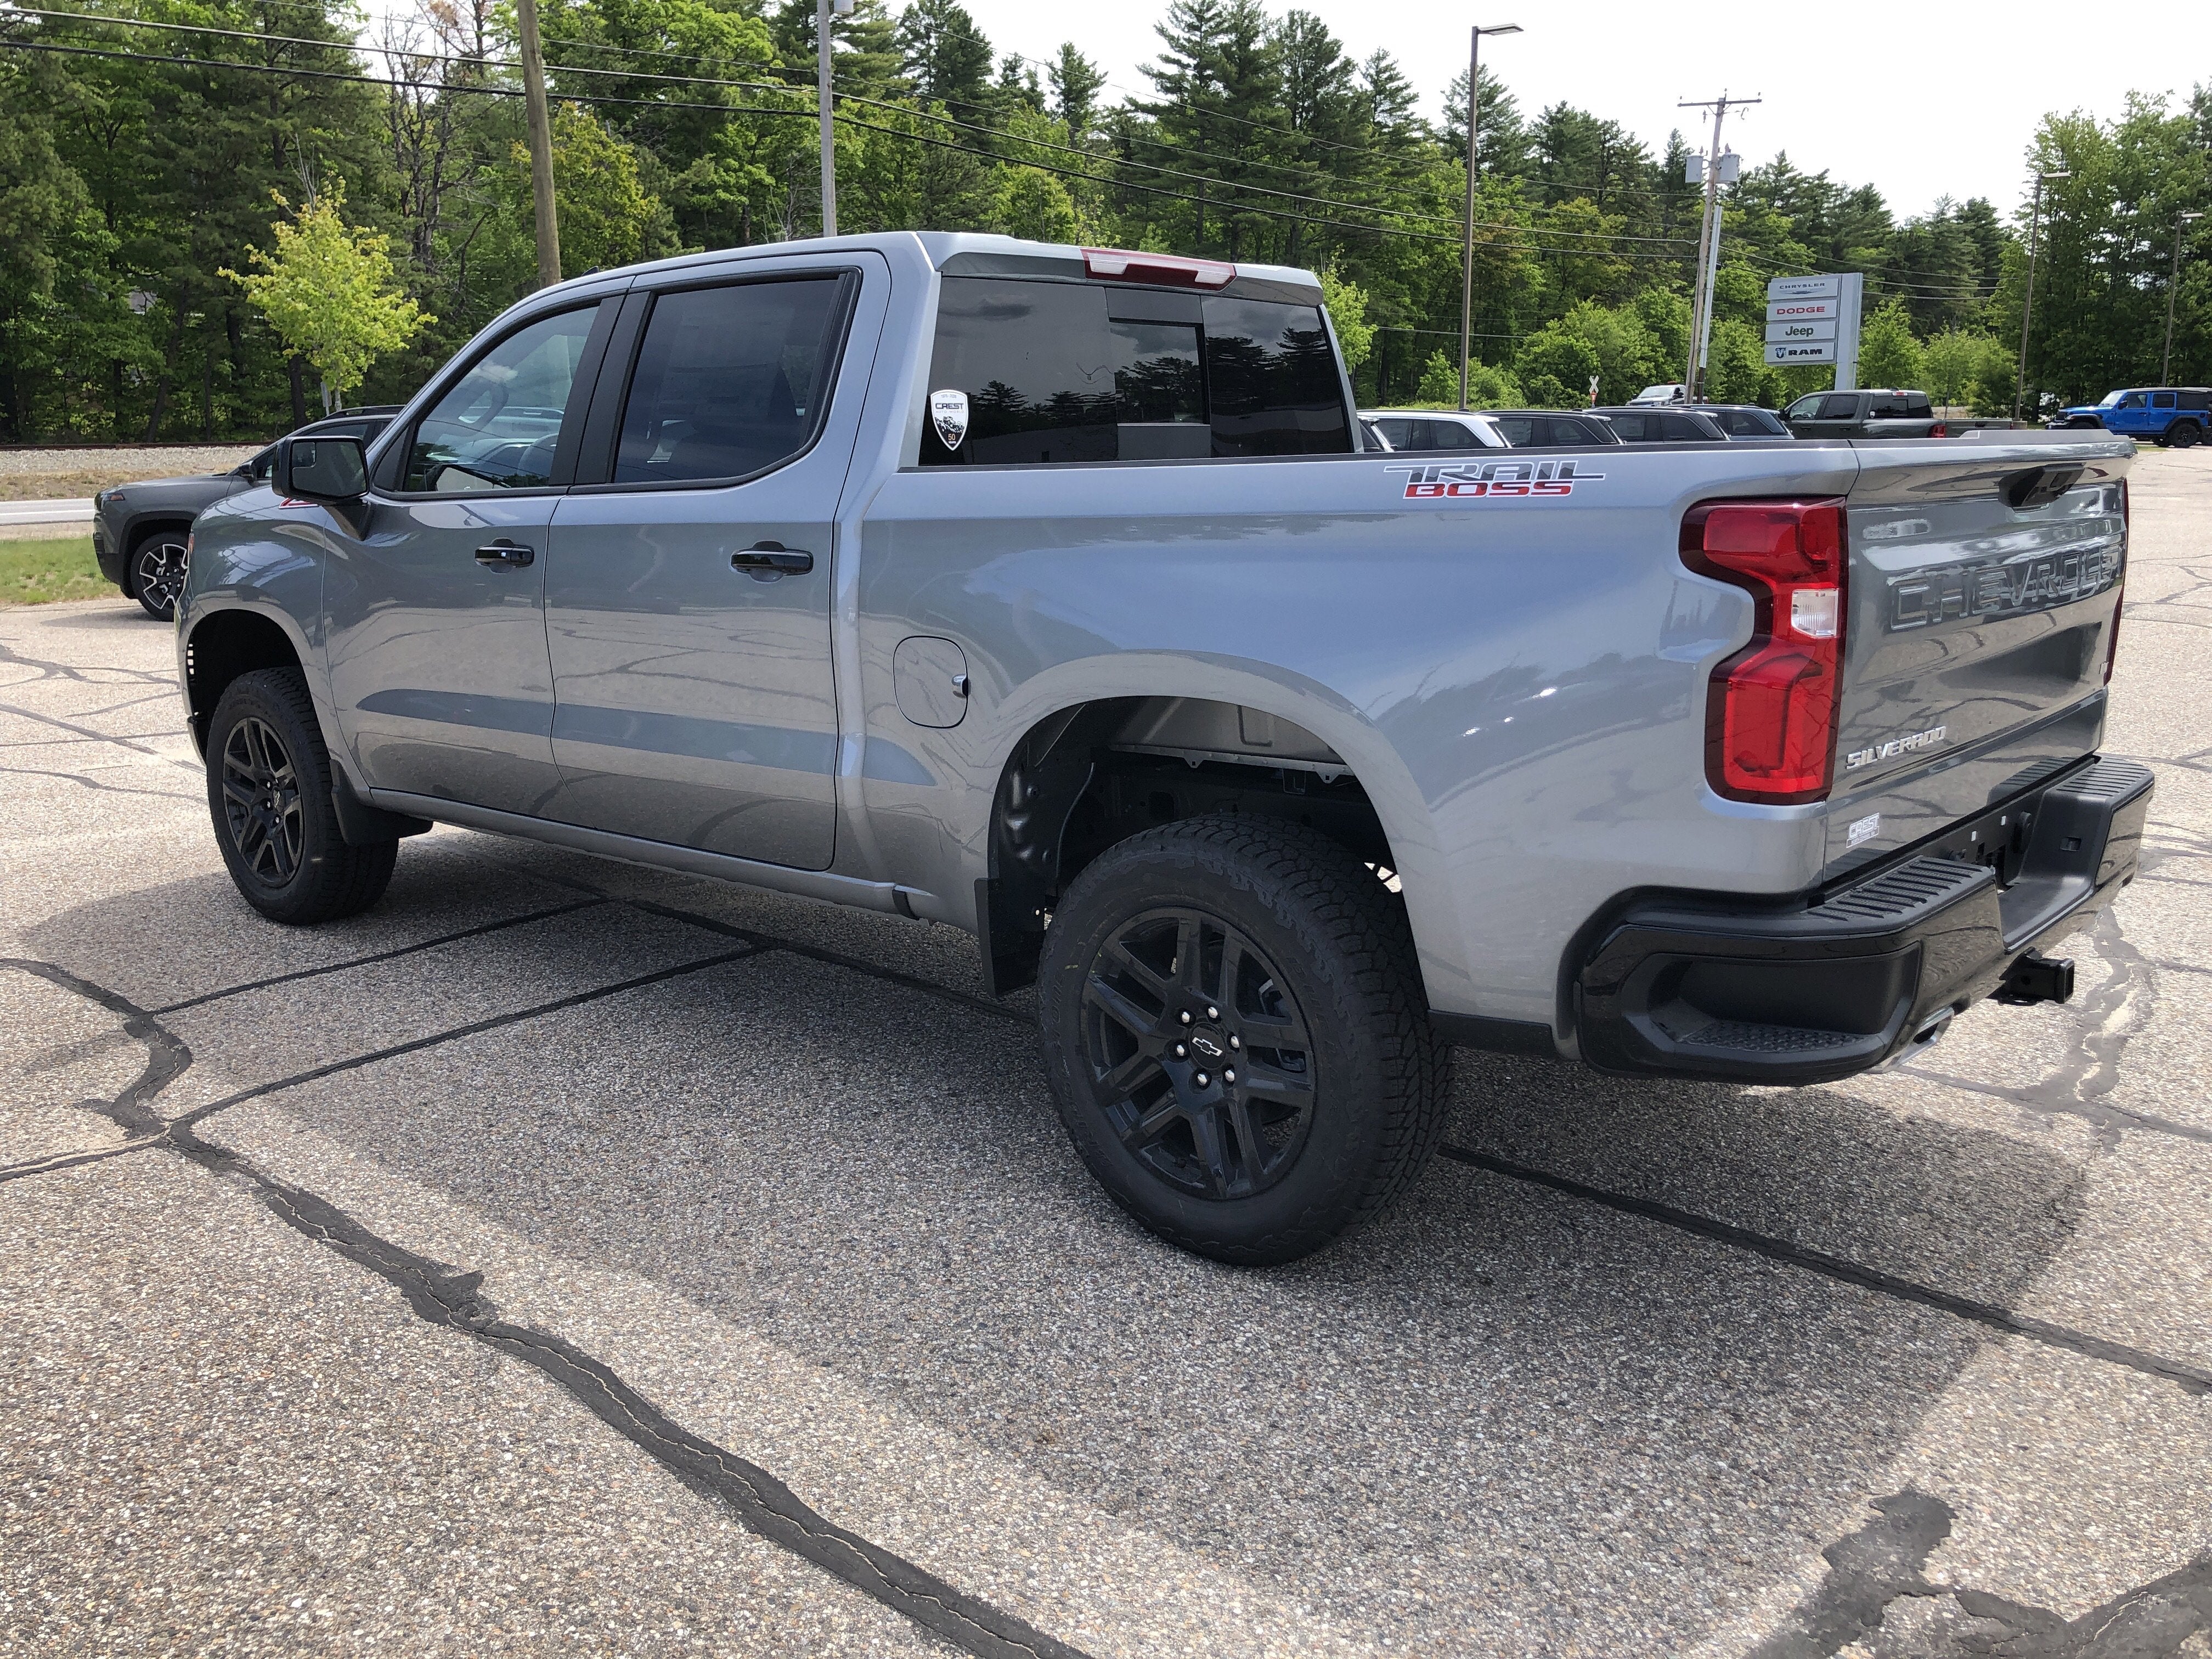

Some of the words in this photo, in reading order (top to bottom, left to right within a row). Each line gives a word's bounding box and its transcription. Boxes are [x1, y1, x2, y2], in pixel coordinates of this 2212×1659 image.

[1776, 306, 1825, 315] DODGE
[1785, 326, 1814, 337] Jeep
[1383, 460, 1606, 483] TRAIL
[1403, 480, 1575, 499] BOSS
[1891, 544, 2123, 631] CHEVROLET
[1846, 726, 1947, 770] SILVERADO
[1848, 812, 1880, 840] CREST
